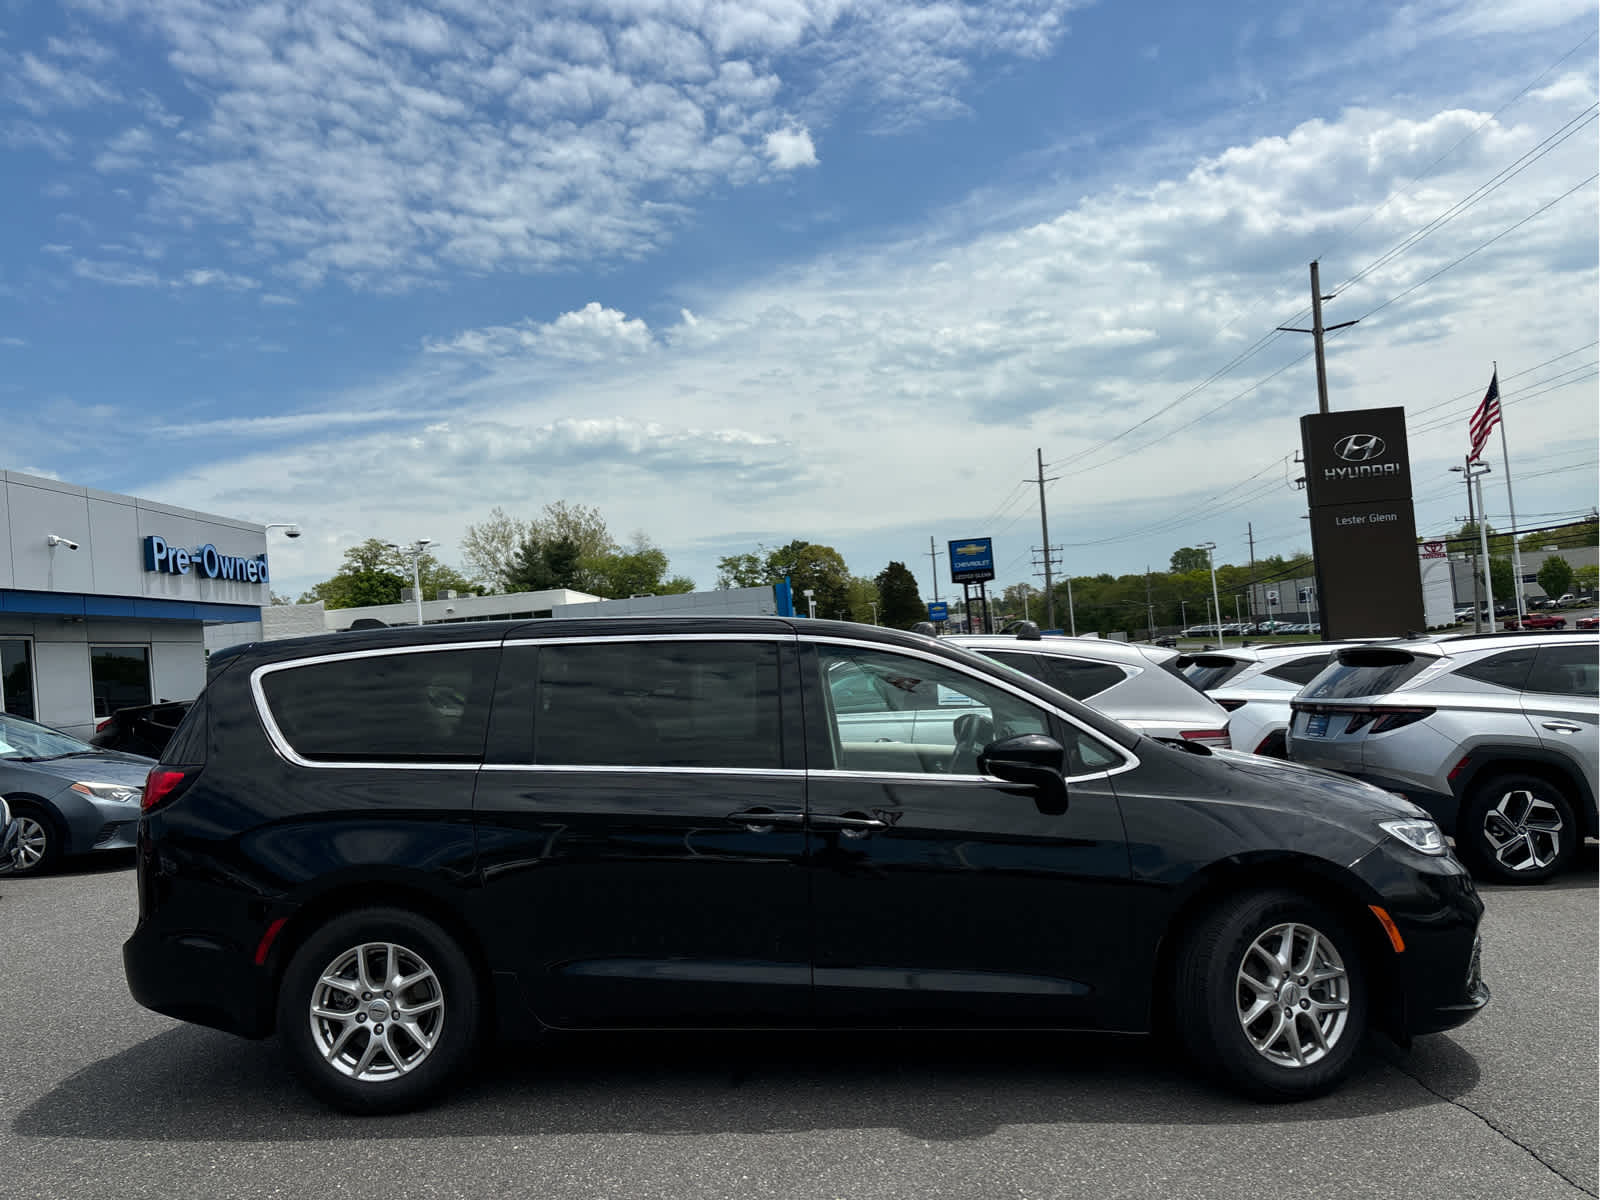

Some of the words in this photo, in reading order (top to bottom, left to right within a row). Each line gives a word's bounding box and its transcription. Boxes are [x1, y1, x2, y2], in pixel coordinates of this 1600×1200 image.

[1324, 463, 1400, 480] HYUNDAI
[1336, 515, 1366, 526] Lester
[1369, 513, 1397, 523] Glenn
[144, 536, 269, 583] Pre-Owned
[954, 560, 989, 568] CHEVROLET
